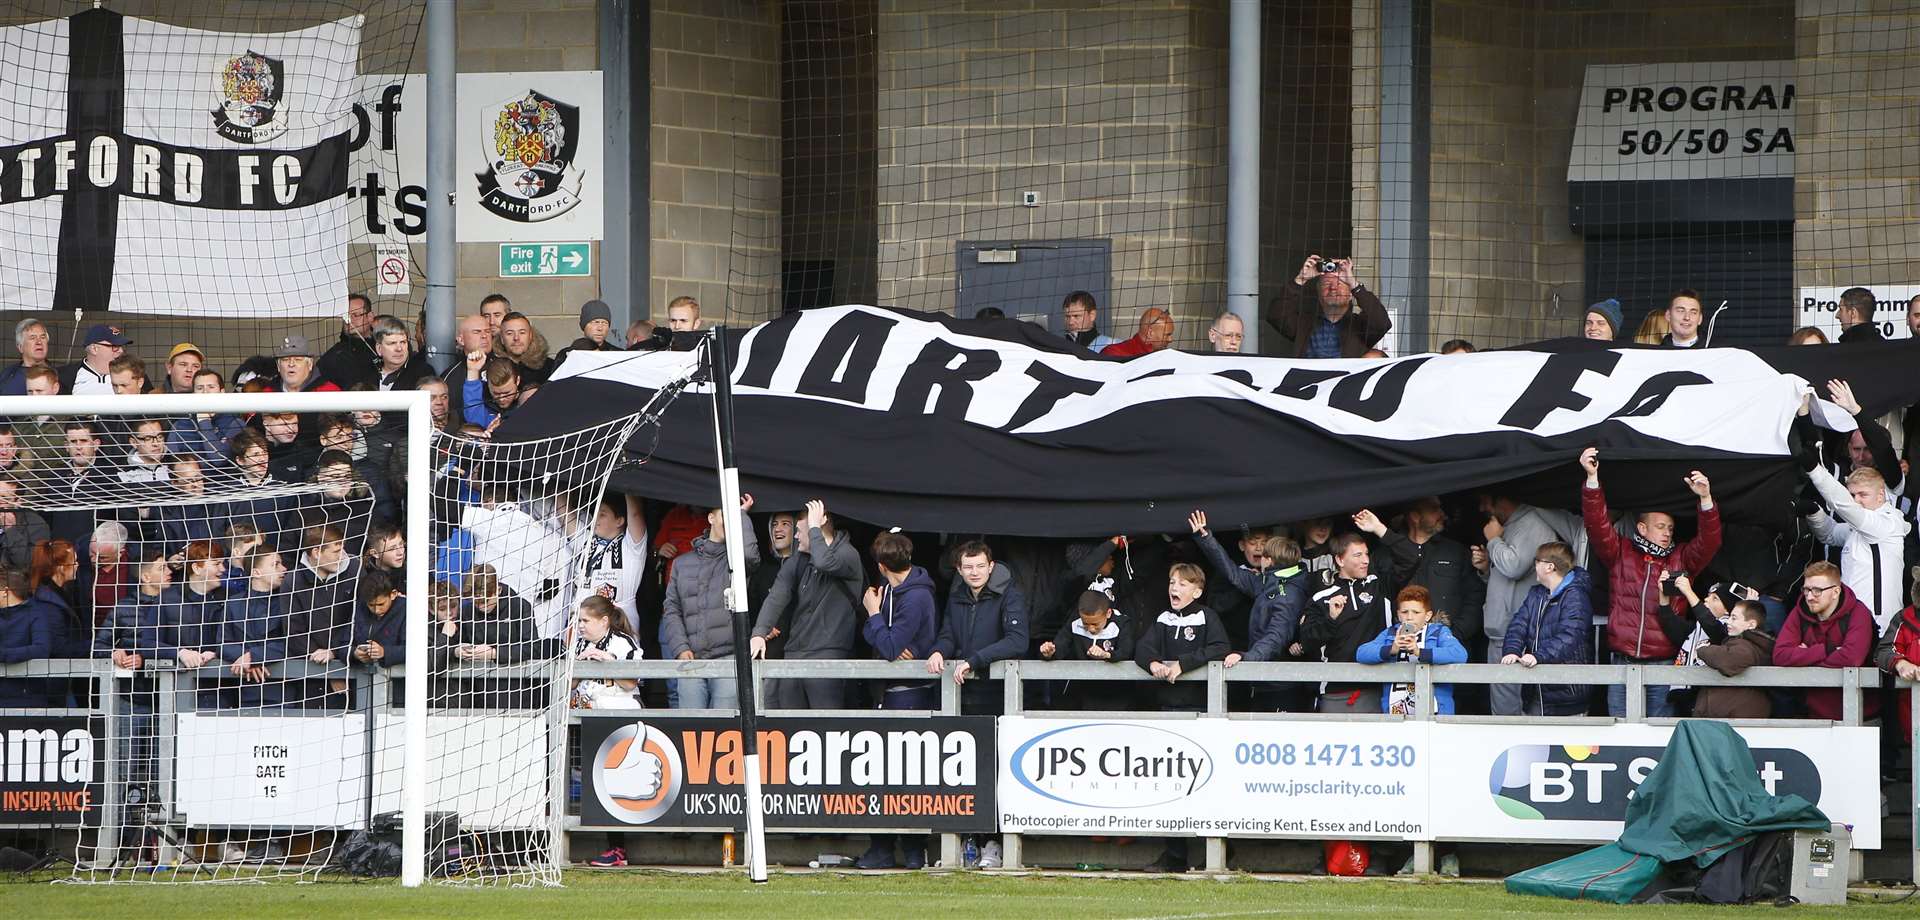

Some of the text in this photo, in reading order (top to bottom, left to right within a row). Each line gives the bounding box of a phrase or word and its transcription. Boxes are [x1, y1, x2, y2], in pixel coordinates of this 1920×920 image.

[1618, 129, 1730, 155] 50/50
[0, 135, 302, 206] TFORD FC
[510, 247, 534, 259] Fire
[510, 261, 532, 273] exit
[0, 728, 94, 783] ma
[253, 745, 288, 759] PITCH
[682, 730, 976, 787] vanarama
[1235, 743, 1416, 767] 0808 1471 330
[256, 765, 286, 779] GATE
[1036, 746, 1204, 796] JPS Clarity
[264, 786, 277, 798] 15
[1244, 779, 1406, 798] www.jpsclarity.co.uk
[1530, 762, 1617, 803] BT
[3, 791, 91, 812] INSURANCE
[684, 794, 716, 815] UK'S
[719, 794, 743, 815] NO.
[786, 795, 821, 815] NEW
[822, 794, 866, 815] VANS
[868, 794, 881, 815] &
[884, 795, 975, 815] INSURANCE
[1003, 813, 1422, 834] Photocopier and Printer suppliers servicing Kent, Essex and London
